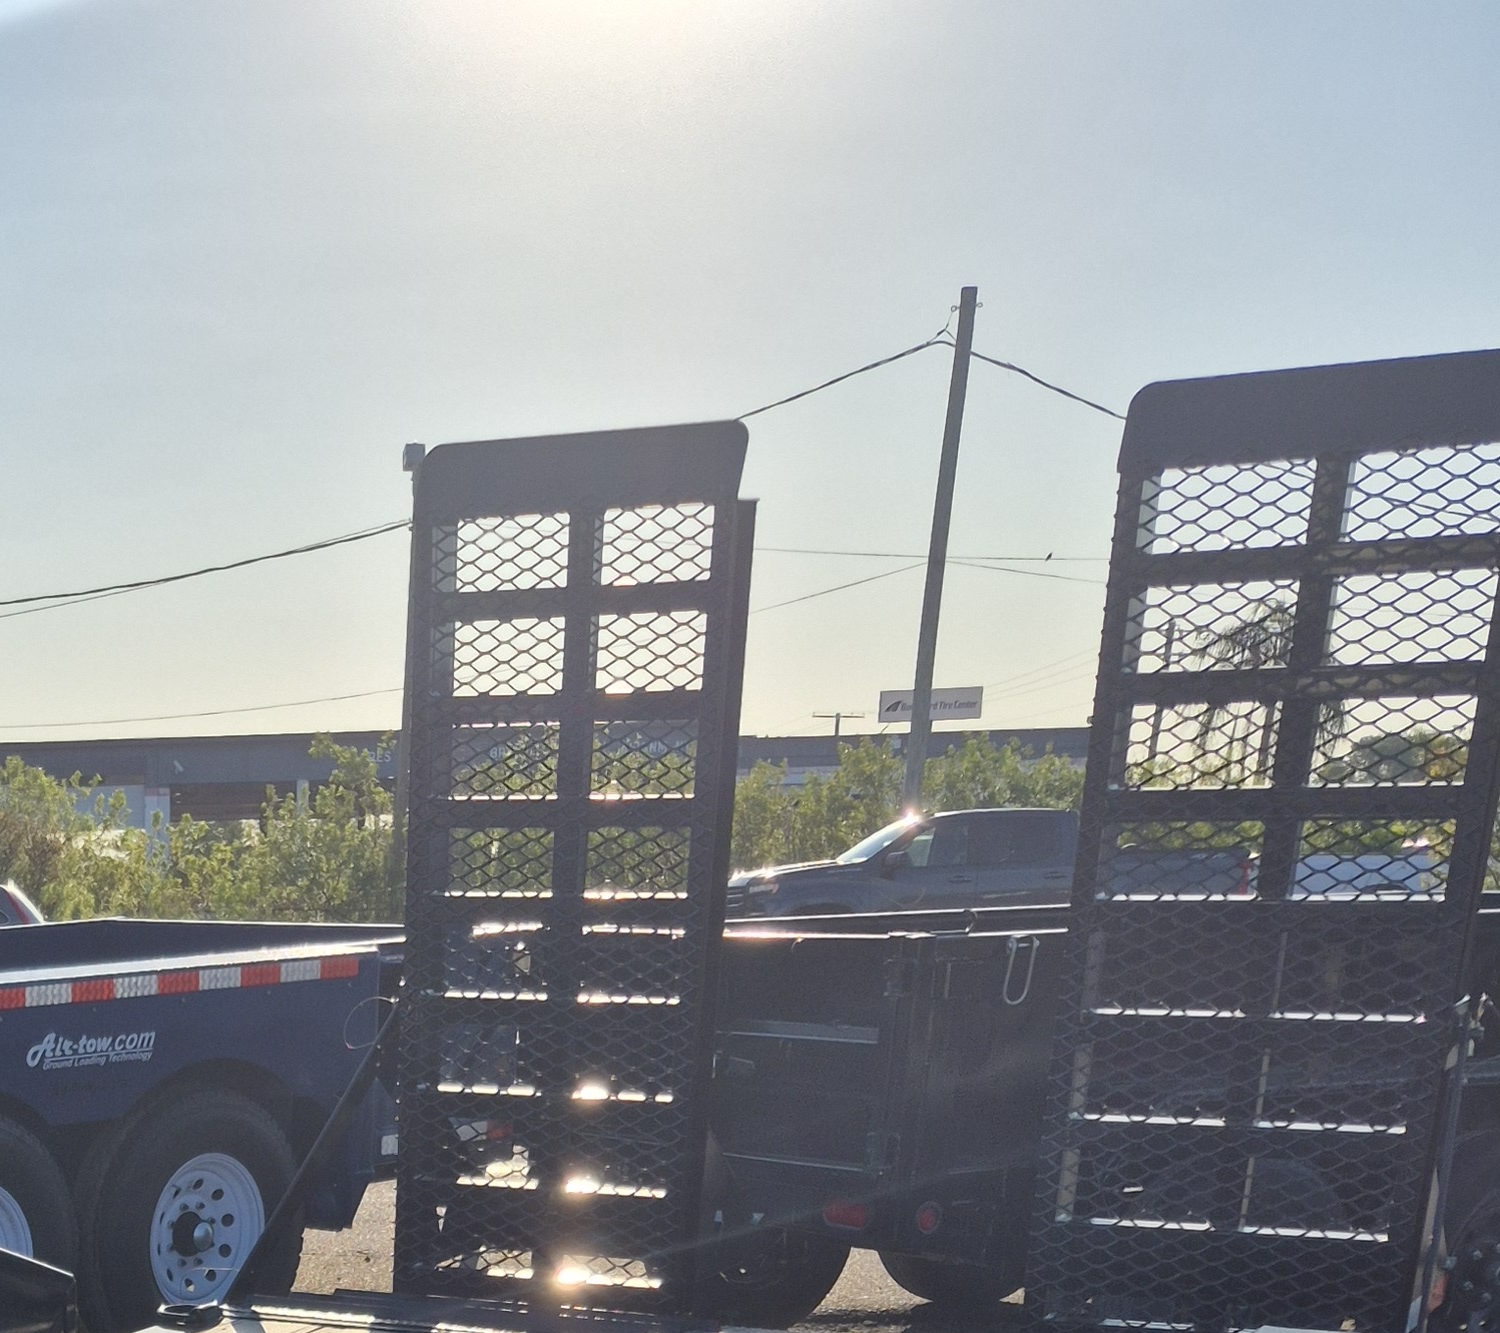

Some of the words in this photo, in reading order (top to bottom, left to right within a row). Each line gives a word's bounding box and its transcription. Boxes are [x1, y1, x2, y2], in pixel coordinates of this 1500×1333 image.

[25, 1031, 156, 1068] Air-tow.com
[42, 1058, 73, 1070] Ground
[73, 1055, 106, 1067] Loading
[108, 1050, 153, 1062] Technology
